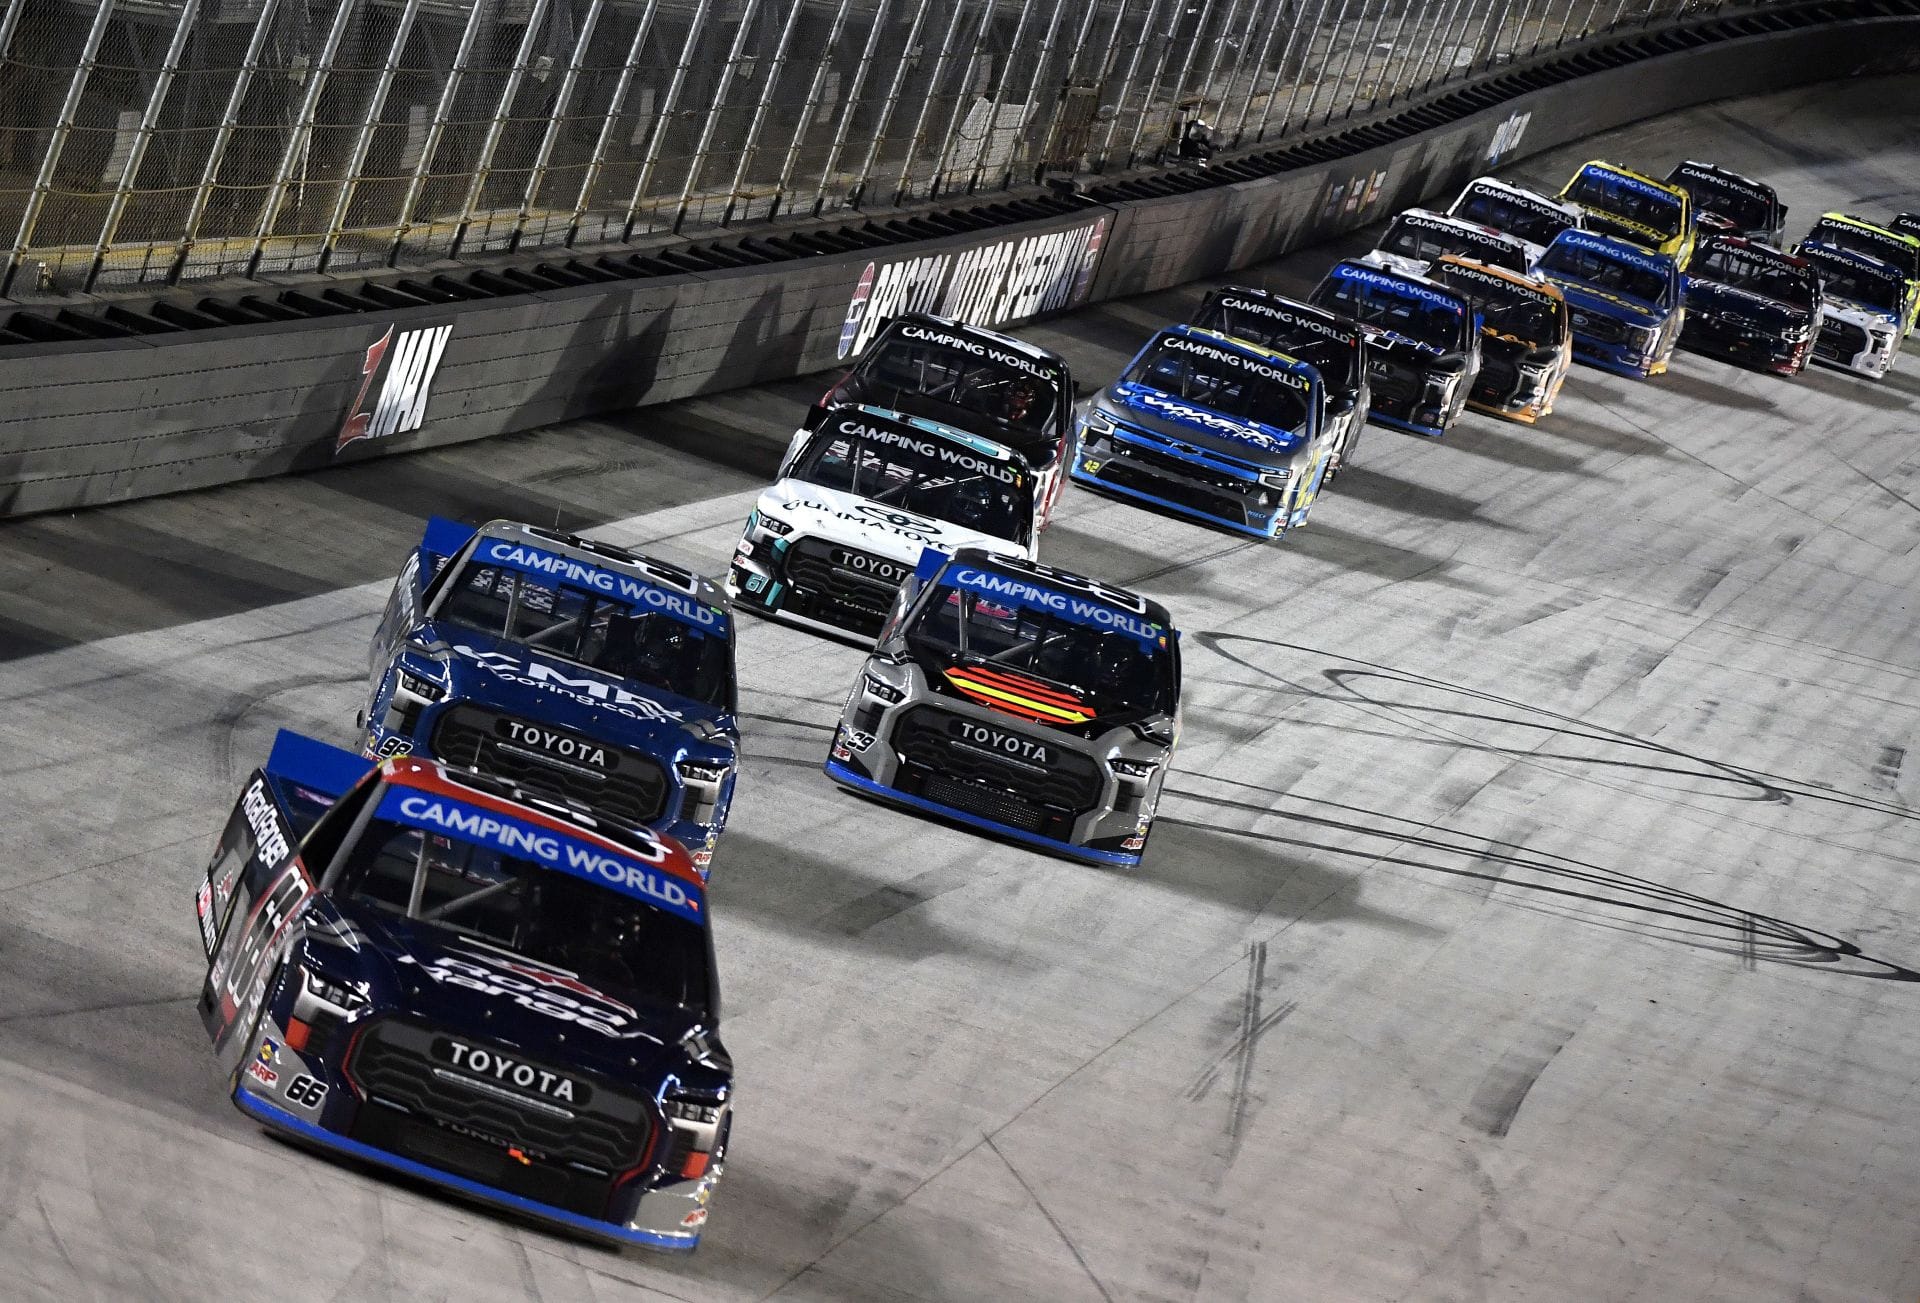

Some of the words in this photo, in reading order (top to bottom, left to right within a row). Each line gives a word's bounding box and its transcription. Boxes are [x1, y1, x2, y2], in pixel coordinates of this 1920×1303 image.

[1474, 185, 1529, 209] CAMPING
[1530, 202, 1573, 226] WORLD
[1589, 167, 1637, 188] CAMPING
[1640, 183, 1678, 205] WORLD
[1682, 168, 1728, 187] CAMPING
[1730, 182, 1766, 202] WORLD
[1405, 216, 1464, 241] CAMPING
[1466, 230, 1513, 254] WORLD
[1565, 235, 1619, 257] CAMPING
[1621, 251, 1665, 275] WORLD
[1822, 219, 1872, 238] CAMPING
[1873, 233, 1914, 254] WORLD
[940, 241, 1014, 327] MOTOR
[995, 224, 1096, 325] SPEEDWAY
[1712, 242, 1763, 262] CAMPING
[1766, 257, 1806, 277] WORLD
[1805, 246, 1853, 266] CAMPING
[1855, 261, 1893, 281] WORLD
[1341, 267, 1406, 292] CAMPING
[1408, 283, 1461, 310] WORLD
[1441, 263, 1503, 289] CAMPING
[1505, 281, 1555, 306] WORLD
[1221, 297, 1293, 323] CAMPING
[1295, 316, 1350, 344] WORLD
[902, 326, 985, 357] CAMPING
[987, 348, 1052, 381] WORLD
[1163, 337, 1240, 367] CAMPING
[1242, 357, 1303, 390] WORLD
[839, 420, 936, 457] CAMPING
[939, 447, 1014, 485] WORLD
[490, 543, 613, 590] CAMPING
[619, 577, 714, 625] WORLD
[745, 573, 770, 594] 61
[842, 551, 906, 580] TOYOT
[956, 569, 1066, 610] CAMPING
[1072, 598, 1157, 640] WORLD
[510, 721, 605, 767] TOYOTA
[961, 722, 1047, 763] TOYOTA
[400, 798, 559, 861] CAMPING
[565, 845, 687, 906] WORLD
[248, 1061, 279, 1084] ARP
[285, 1073, 329, 1110] 66
[451, 1042, 574, 1102] TOYOTA
